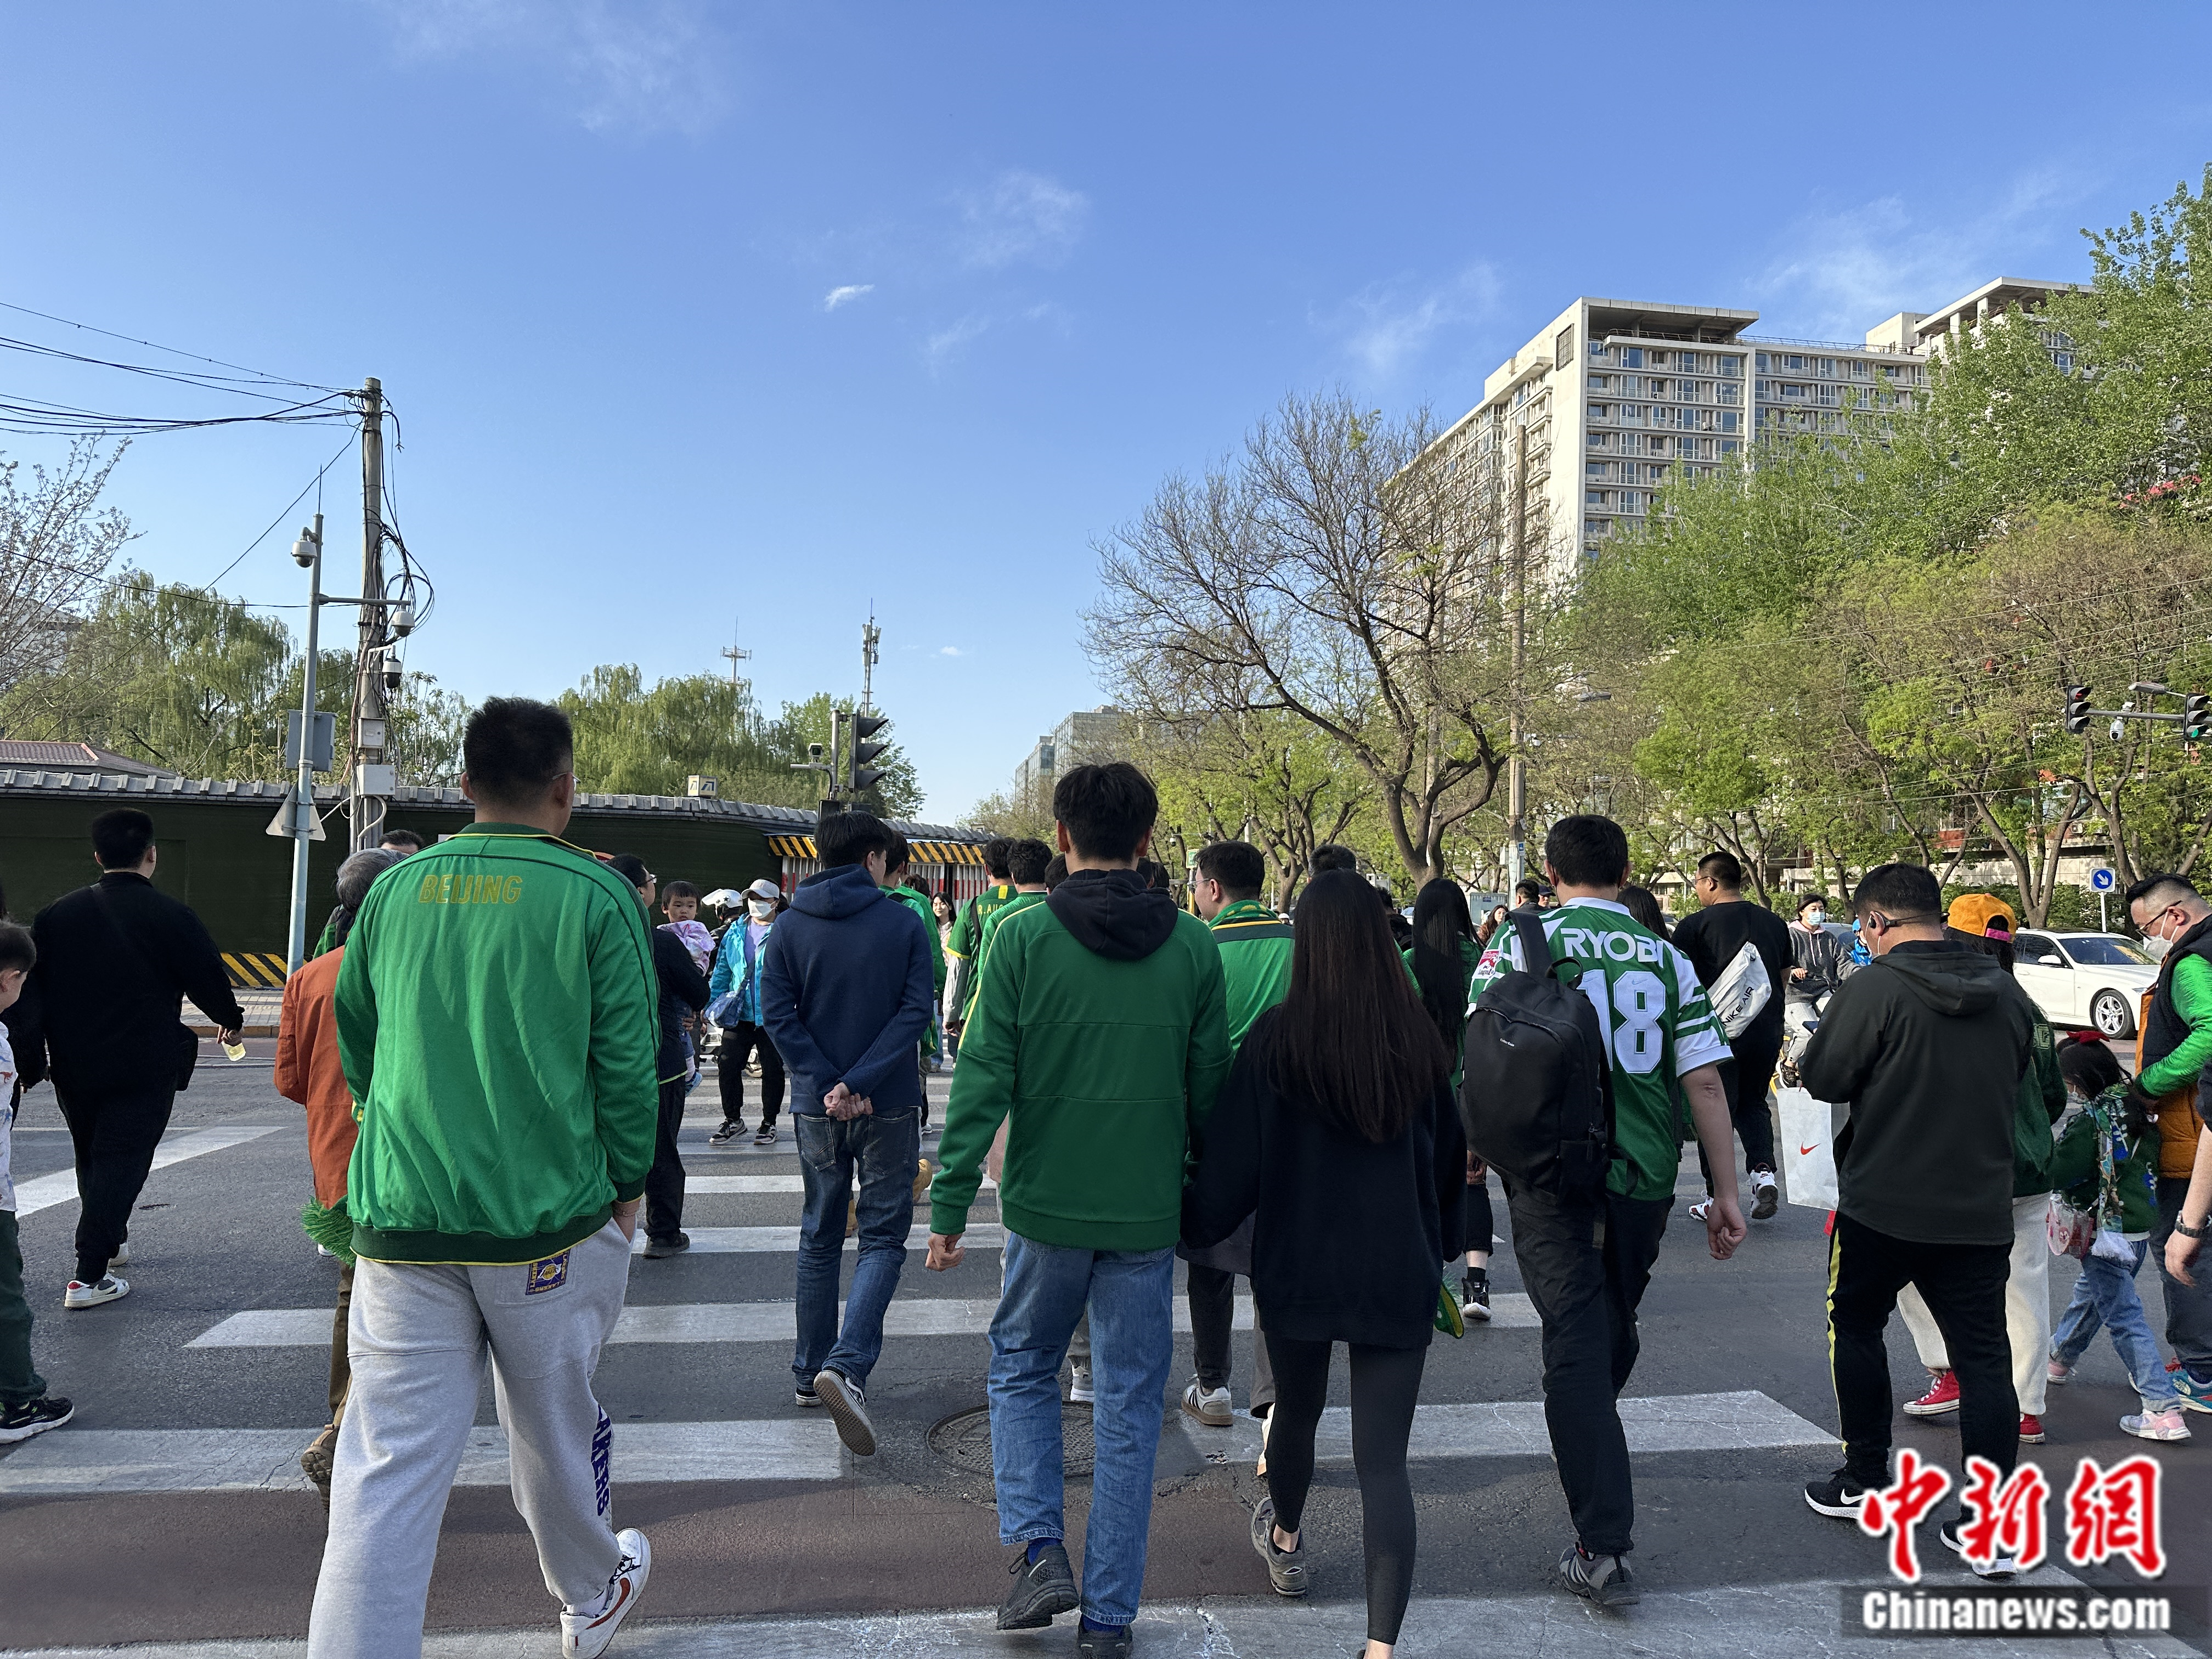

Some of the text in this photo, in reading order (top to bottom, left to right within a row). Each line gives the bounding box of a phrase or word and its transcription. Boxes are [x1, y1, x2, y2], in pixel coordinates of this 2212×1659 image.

[418, 873, 523, 904] BEIJING
[1560, 928, 1664, 969] RYOBI
[1576, 969, 1666, 1074] 18
[1722, 986, 1755, 1026] NIKE AIR
